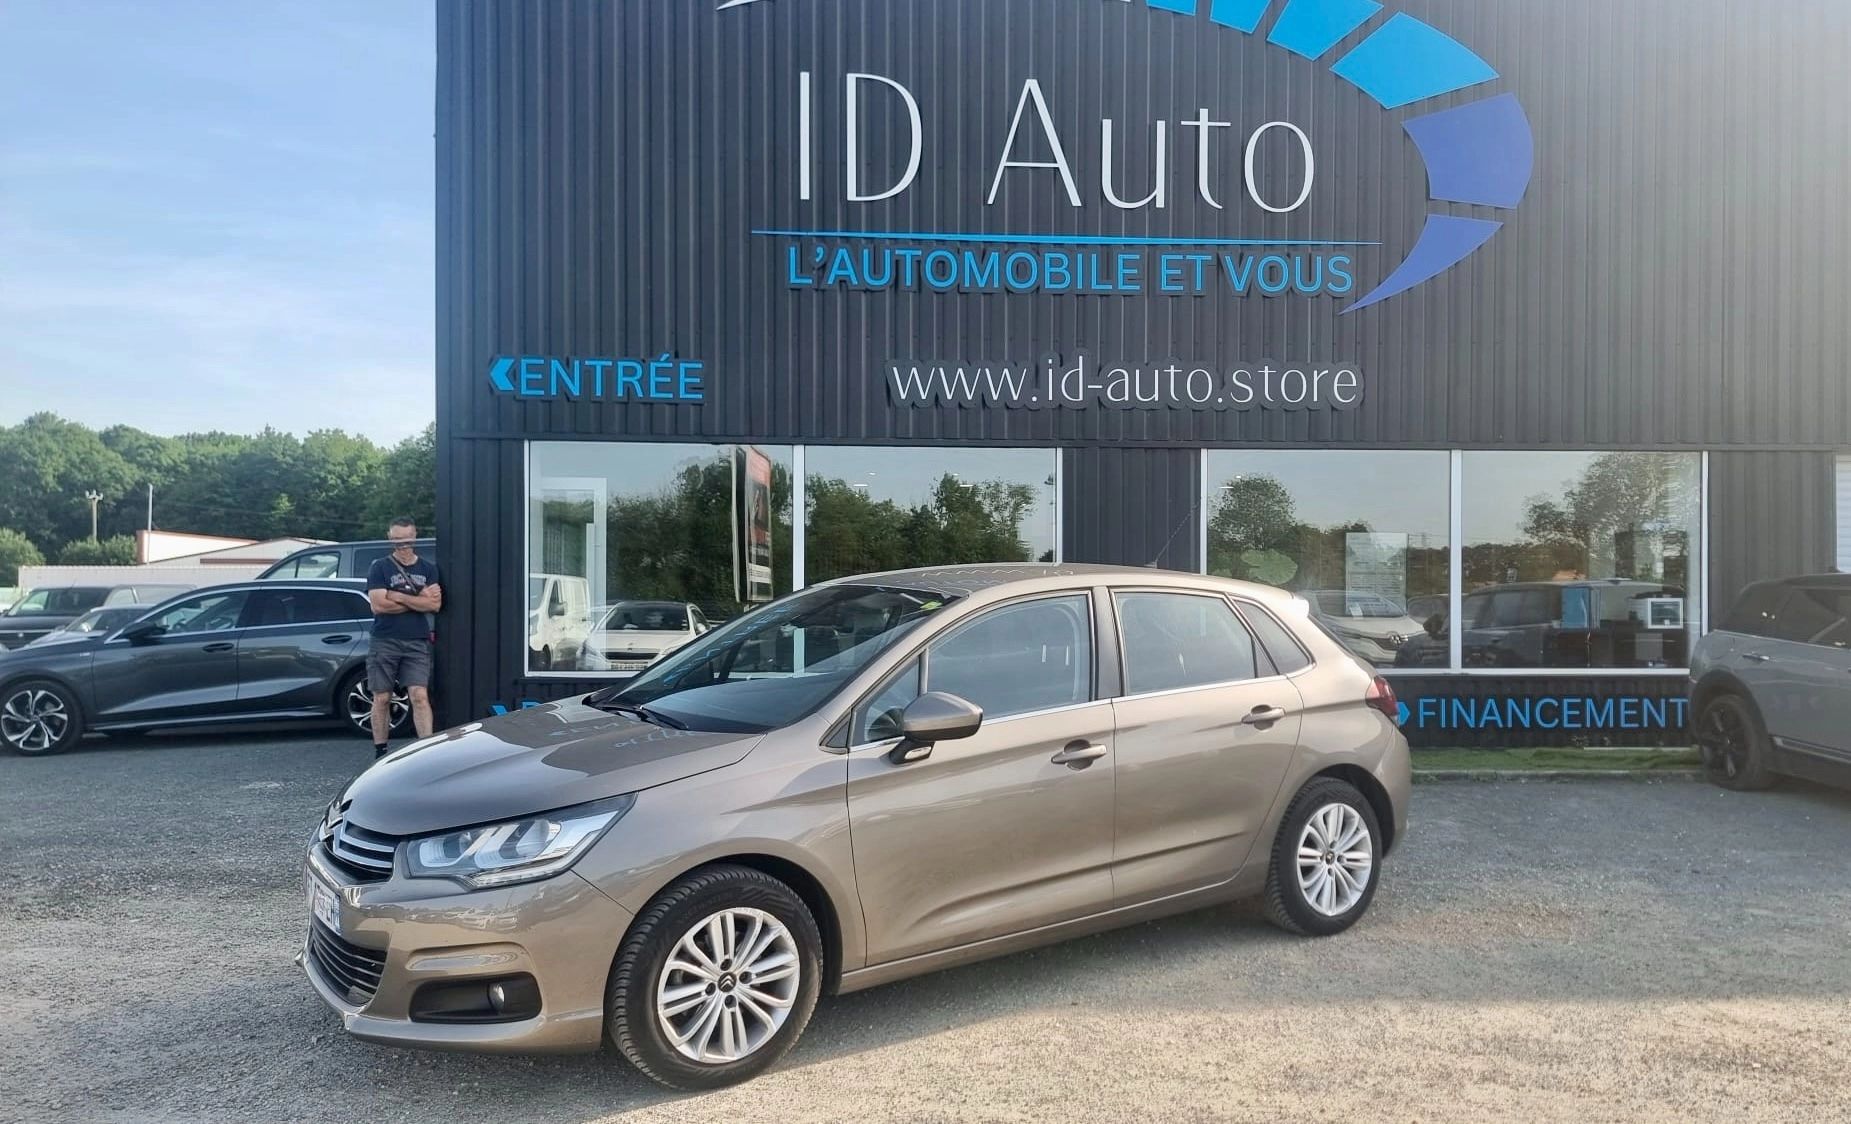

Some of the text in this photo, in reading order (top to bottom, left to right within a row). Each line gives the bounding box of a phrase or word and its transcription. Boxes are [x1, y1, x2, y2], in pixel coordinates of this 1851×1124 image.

[800, 71, 1316, 213] ID Auto
[788, 245, 1354, 294] L'AUTOMOBILE ET VOUS
[517, 352, 704, 401] ENTRÉE
[892, 355, 1359, 405] www.id-auto.store
[1418, 697, 1689, 728] FINANCEMENT
